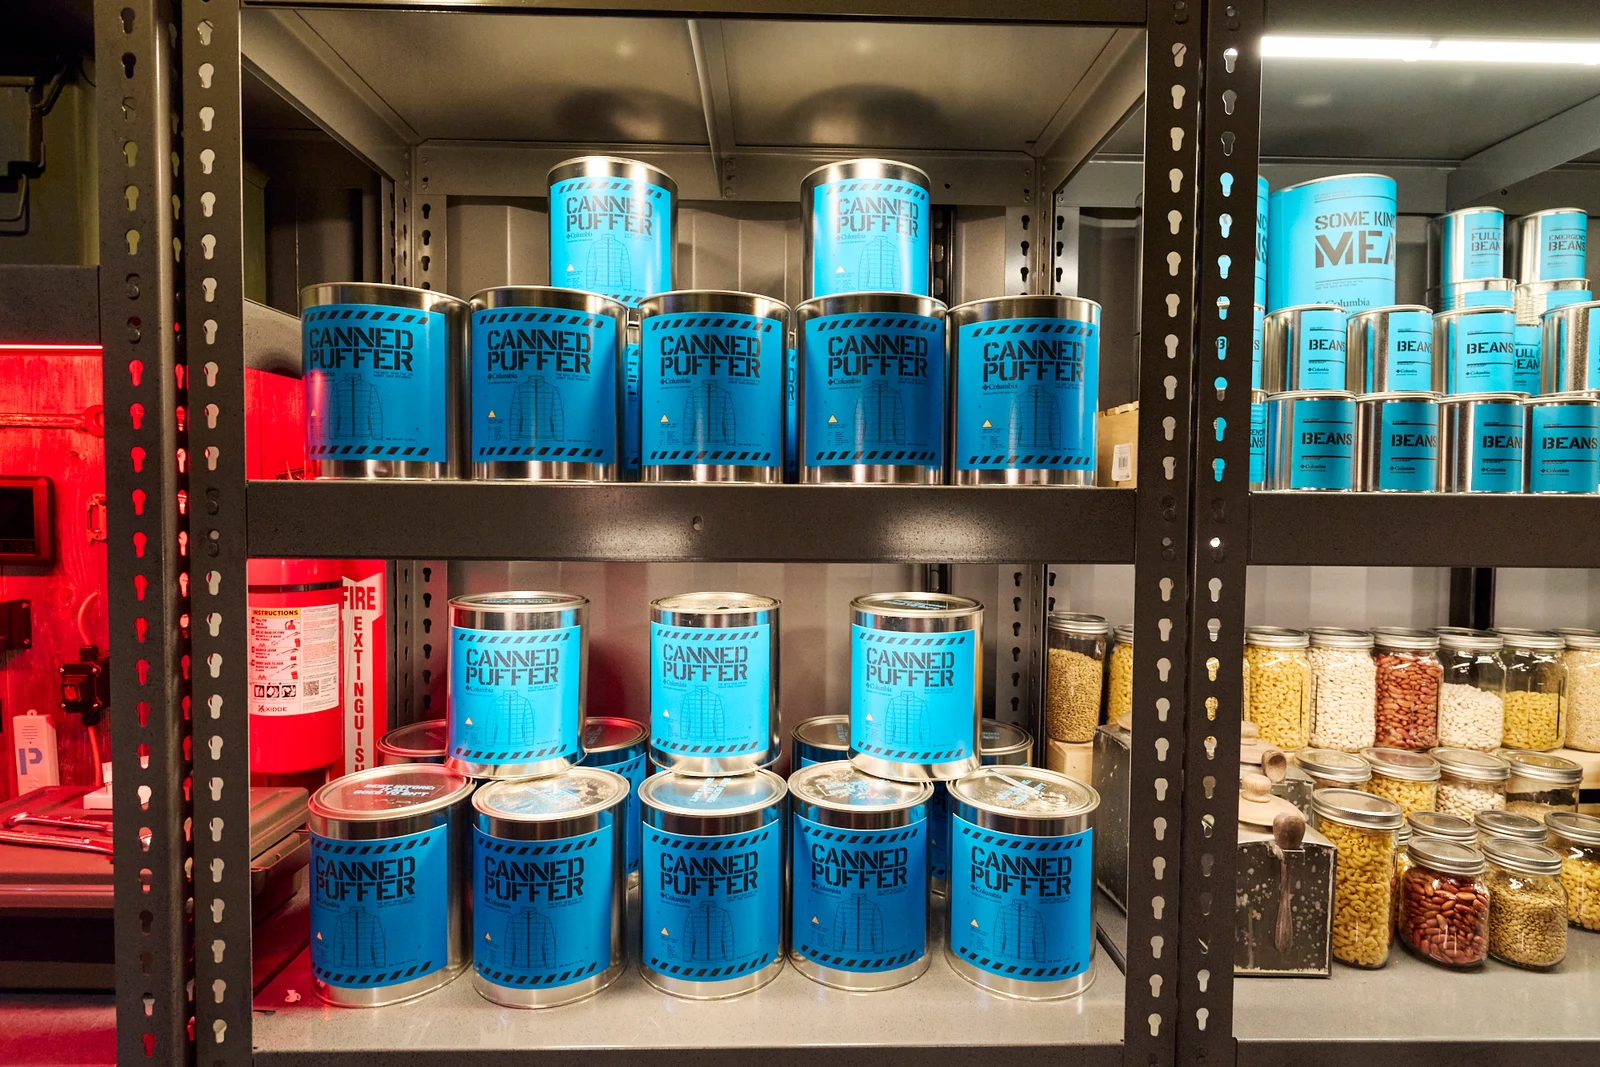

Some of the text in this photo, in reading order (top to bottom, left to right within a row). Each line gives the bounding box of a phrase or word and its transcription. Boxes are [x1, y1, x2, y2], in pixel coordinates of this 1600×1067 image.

[566, 196, 652, 219] CANNED
[836, 197, 918, 218] CANNED
[566, 214, 652, 236] PUFFER
[836, 215, 918, 238] PUFFER
[1315, 211, 1369, 230] SOME
[309, 327, 413, 350] CANNED
[488, 328, 591, 353] CANNED
[661, 335, 761, 357] CANNED
[828, 335, 928, 357] CANNED
[1466, 342, 1513, 354] BEANS
[309, 348, 413, 372] PUFFER
[983, 340, 1084, 361] CANNED
[488, 350, 591, 374] PUFFER
[661, 356, 761, 378] PUFFER
[828, 355, 928, 378] PUFFER
[983, 360, 1084, 382] PUFFER
[1302, 432, 1353, 445] BEANS
[1391, 435, 1438, 448] BEANS
[1543, 437, 1598, 450] BEANS
[342, 586, 375, 610] FIRE
[465, 648, 559, 668] CANNED
[663, 644, 747, 664] CANNED
[866, 647, 954, 669] CANNED
[465, 665, 558, 686] PUFFER
[663, 661, 747, 682] PUFFER
[866, 665, 954, 687] PUFFER
[660, 851, 758, 876] CANNED
[812, 843, 908, 869] CANNED
[971, 845, 1072, 876] CANNED
[316, 855, 415, 882] CANNED
[485, 856, 584, 882] CANNED
[812, 862, 907, 890] PUFFER
[316, 877, 415, 902] PUFFER
[485, 878, 584, 902] PUFFER
[660, 872, 757, 896] PUFFER
[971, 866, 1072, 897] PUFFER
